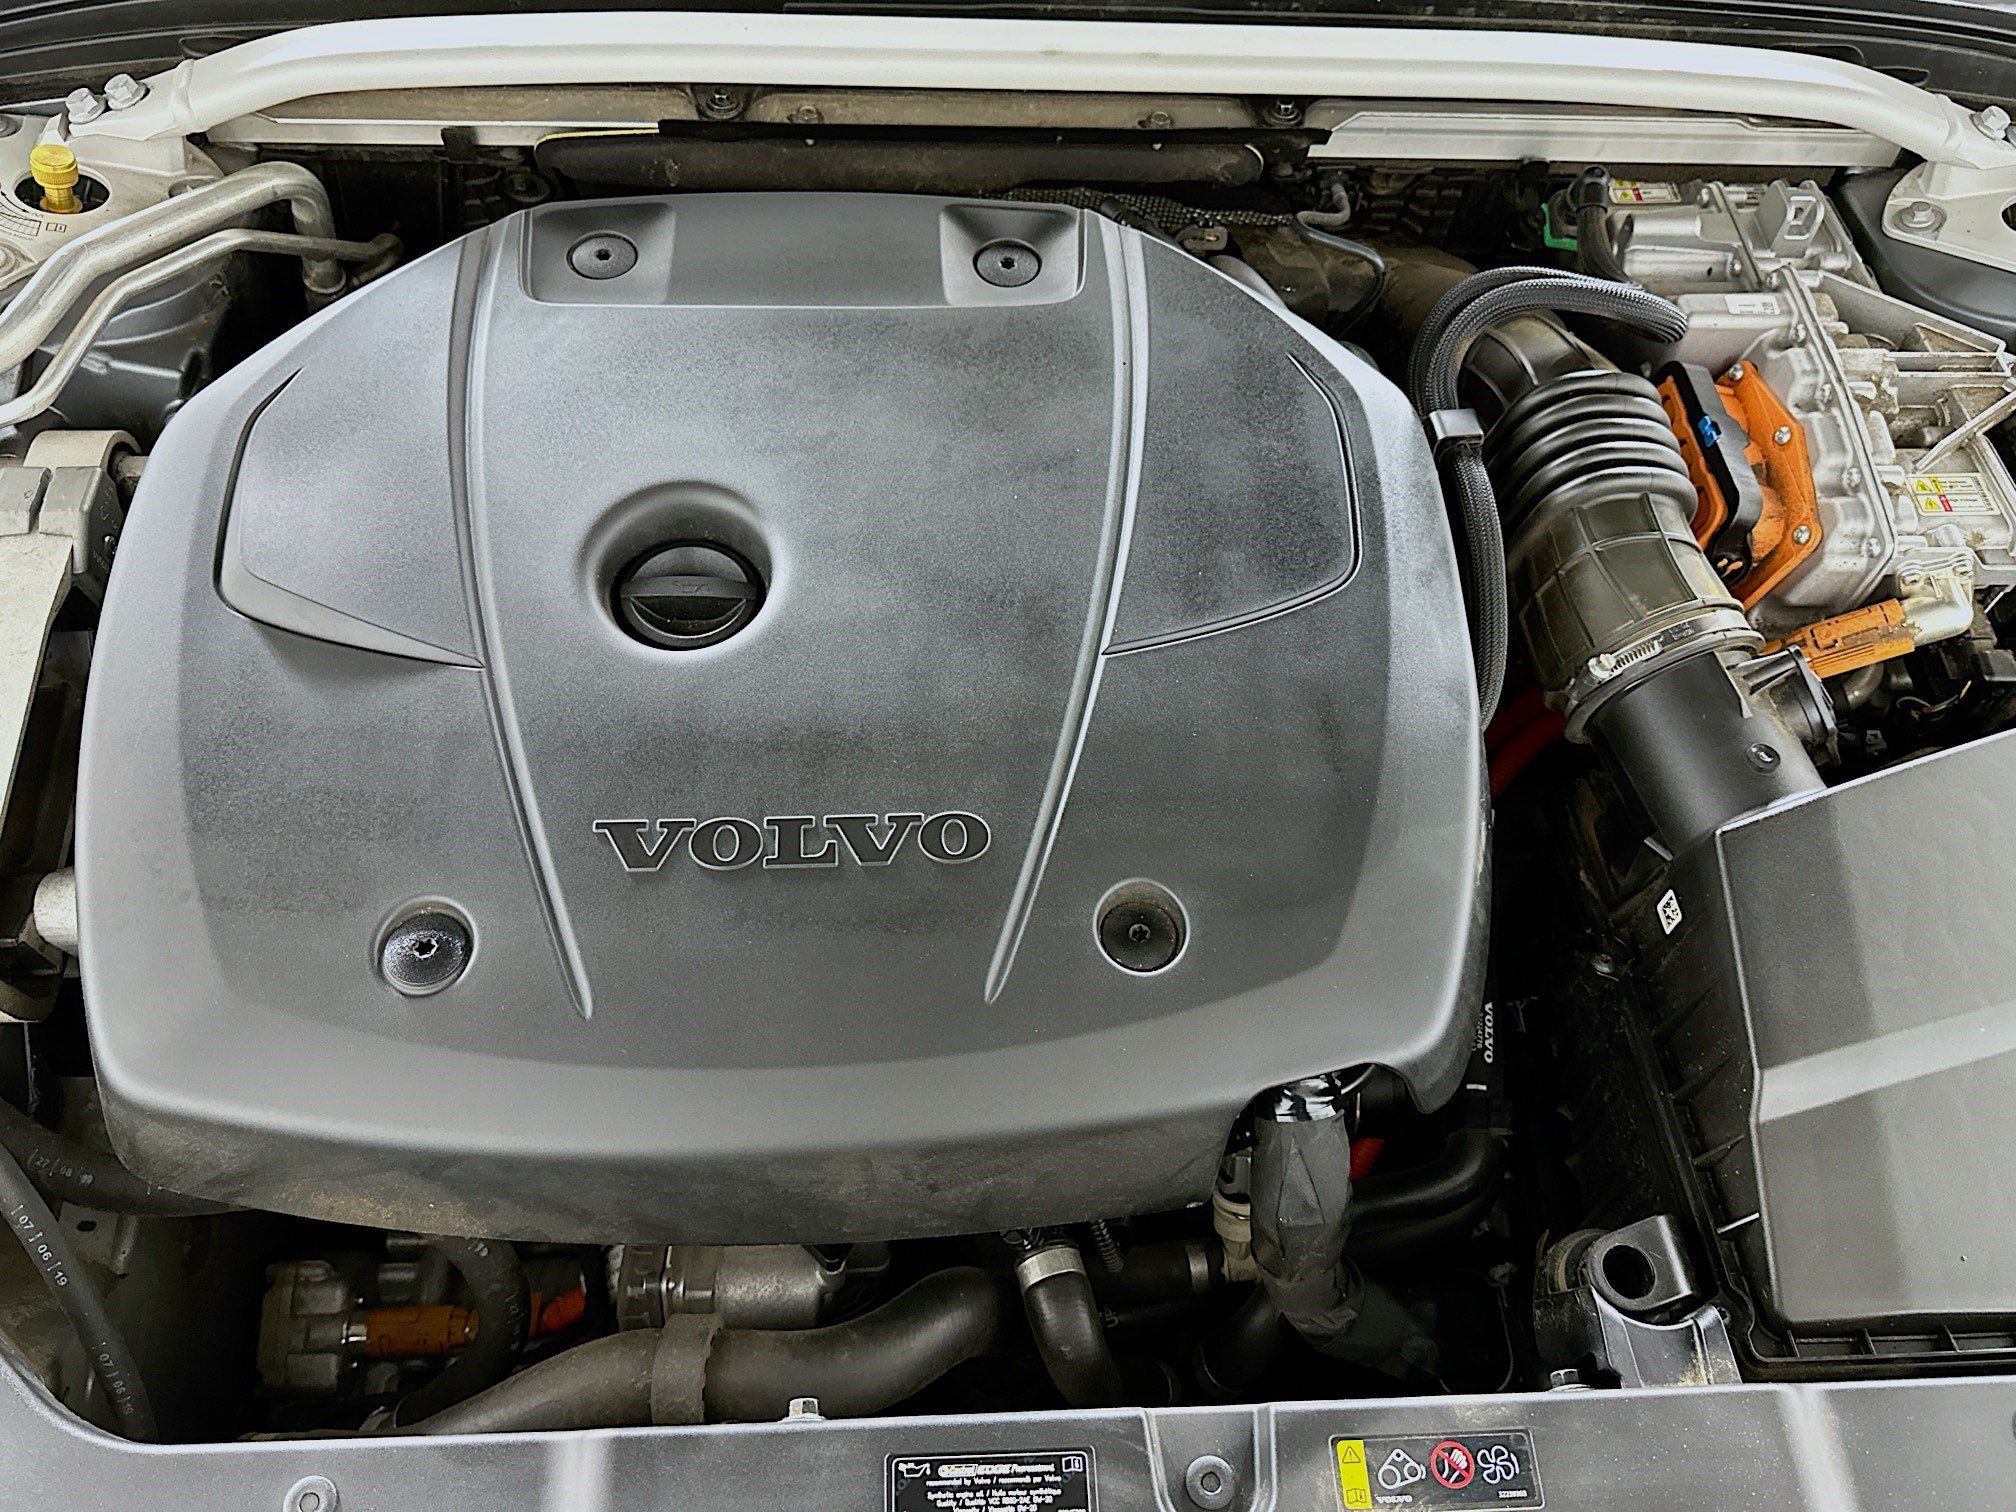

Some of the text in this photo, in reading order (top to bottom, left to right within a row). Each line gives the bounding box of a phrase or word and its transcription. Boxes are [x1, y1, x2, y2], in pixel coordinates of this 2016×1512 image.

[593, 810, 992, 872] VOLVO
[1484, 1001, 1494, 1064] VOLVO
[19, 1215, 68, 1286] 07 06 19
[1376, 1495, 1413, 1504] VOLVO
